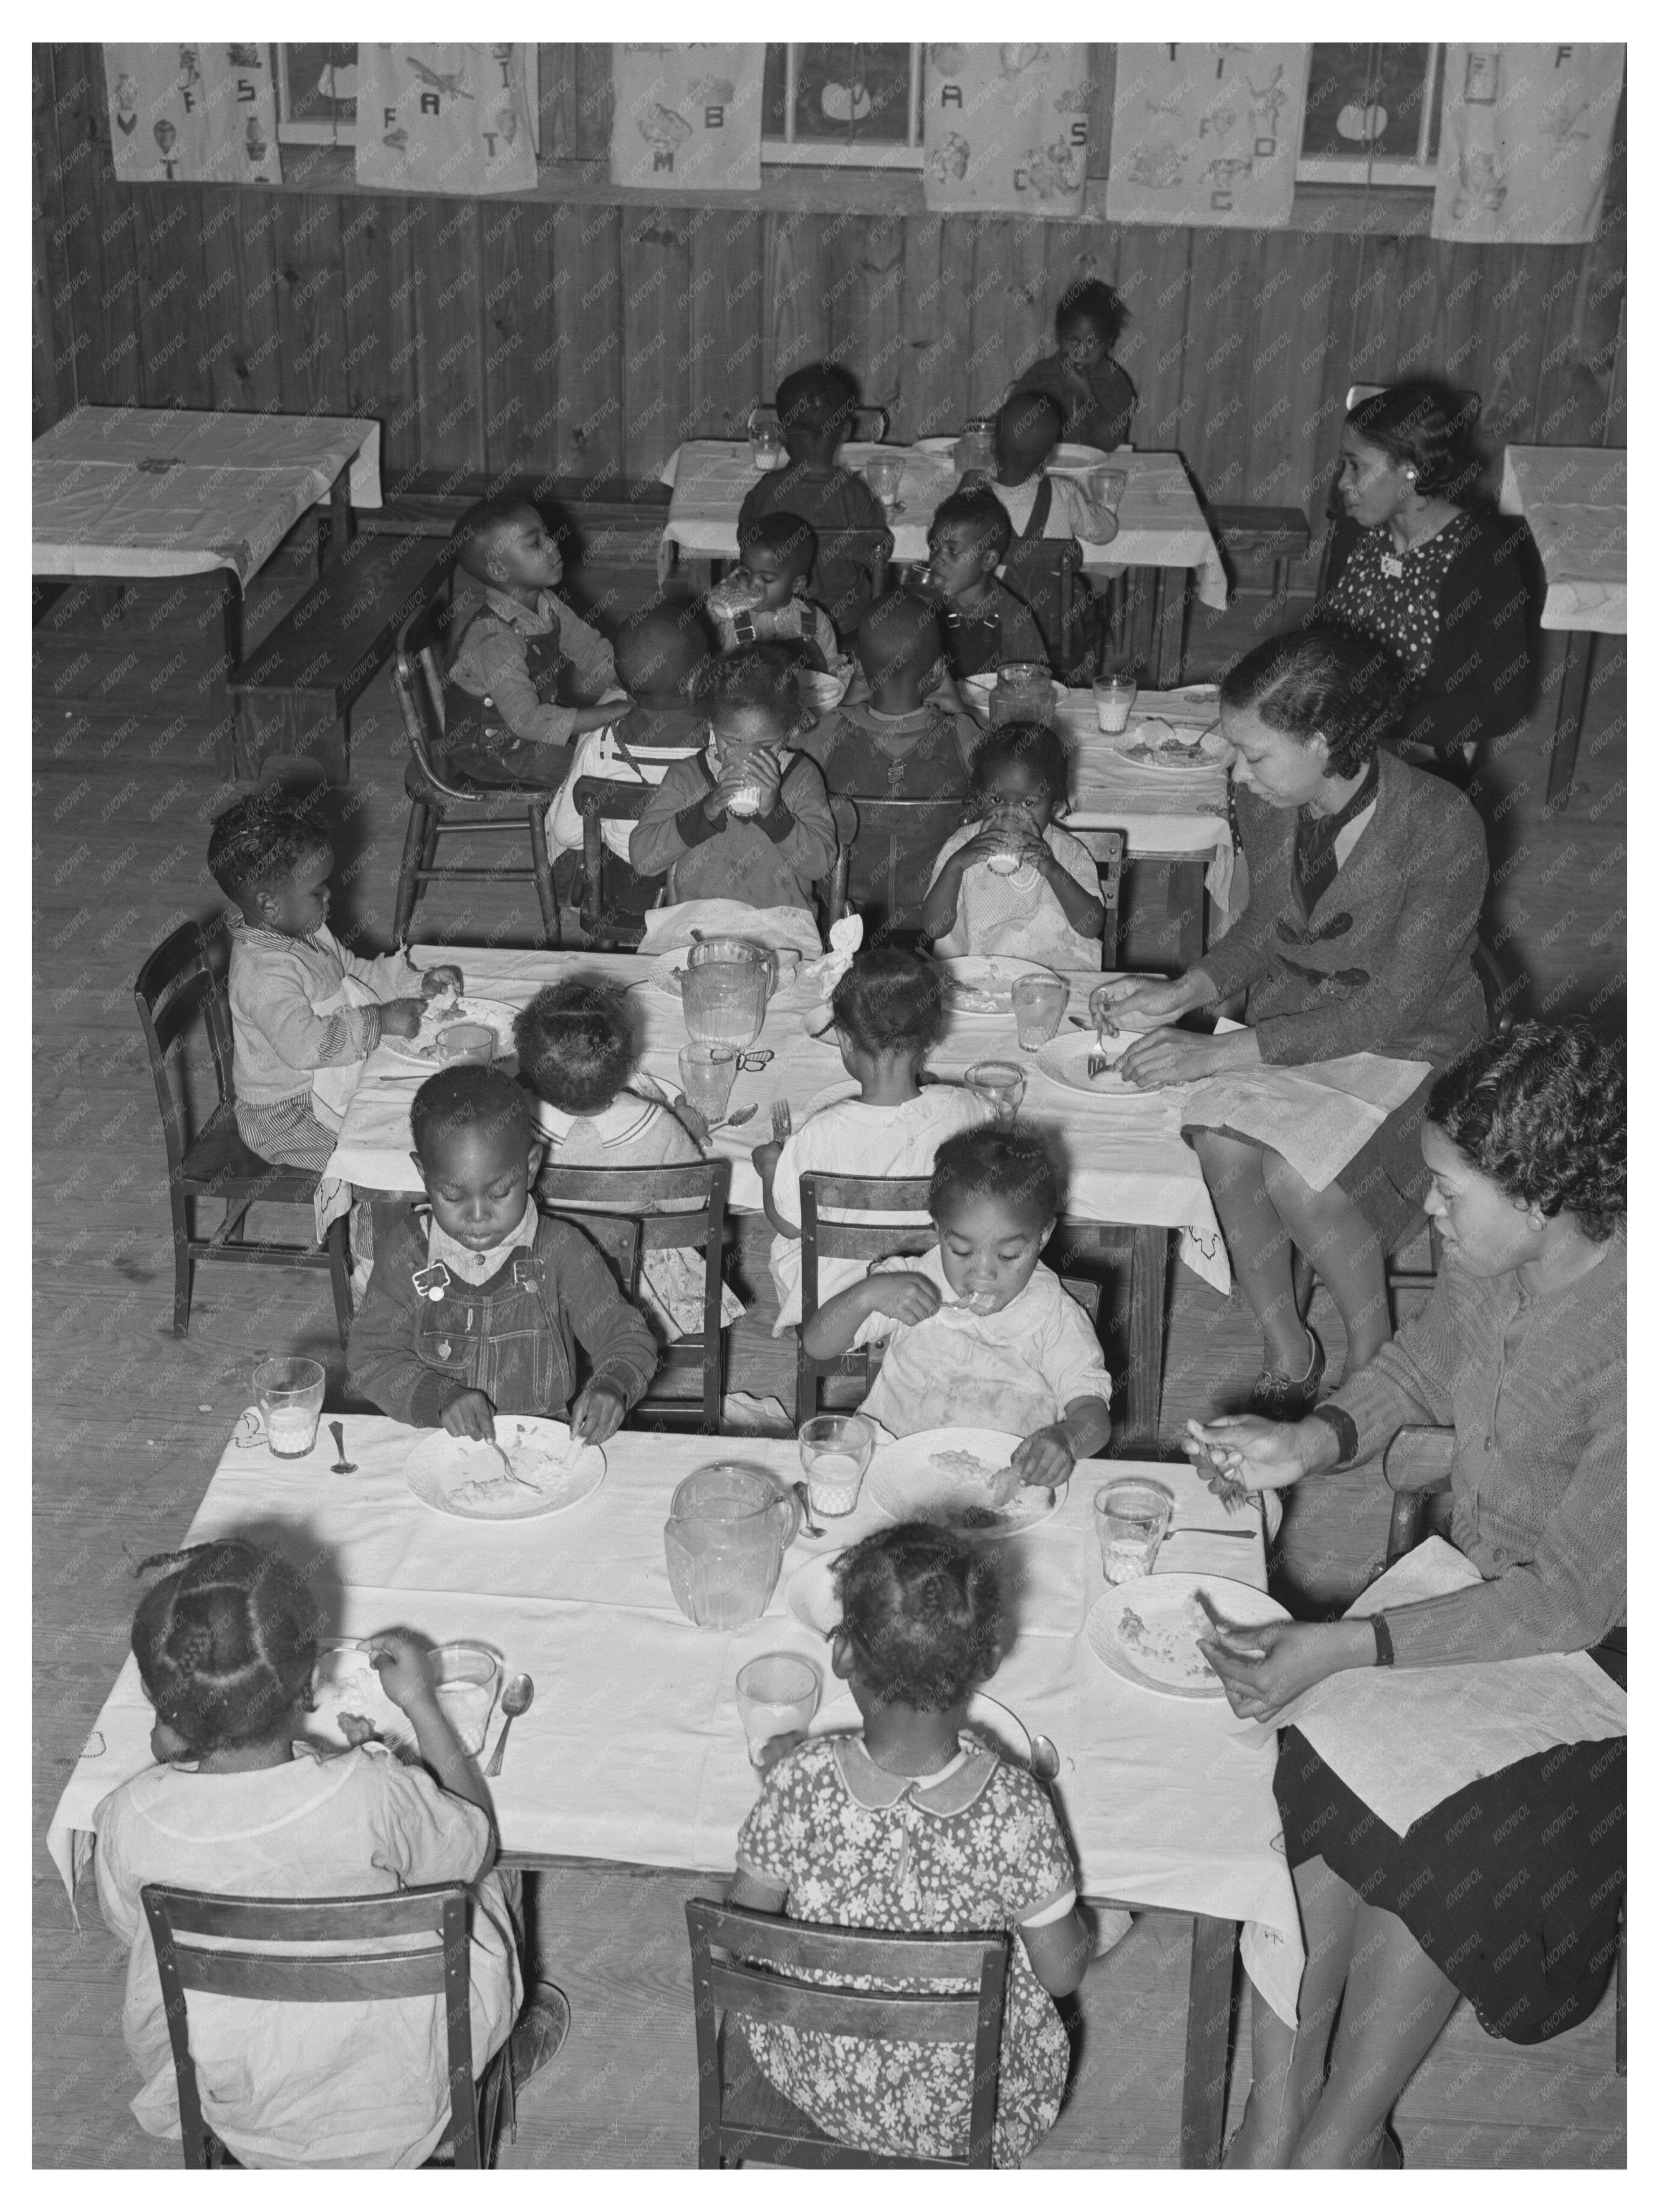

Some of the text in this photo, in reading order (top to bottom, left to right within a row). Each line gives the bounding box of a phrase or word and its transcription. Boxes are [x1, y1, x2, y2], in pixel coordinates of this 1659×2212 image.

[1555, 46, 1571, 69] F
[238, 80, 255, 102] S
[942, 85, 962, 108] A
[184, 92, 195, 113] F
[421, 93, 439, 115] A
[118, 115, 137, 136] V
[384, 108, 396, 129] F
[705, 106, 723, 128] B
[1199, 118, 1210, 138] F
[483, 132, 498, 157] T
[1071, 123, 1086, 146] S
[654, 153, 674, 172] M
